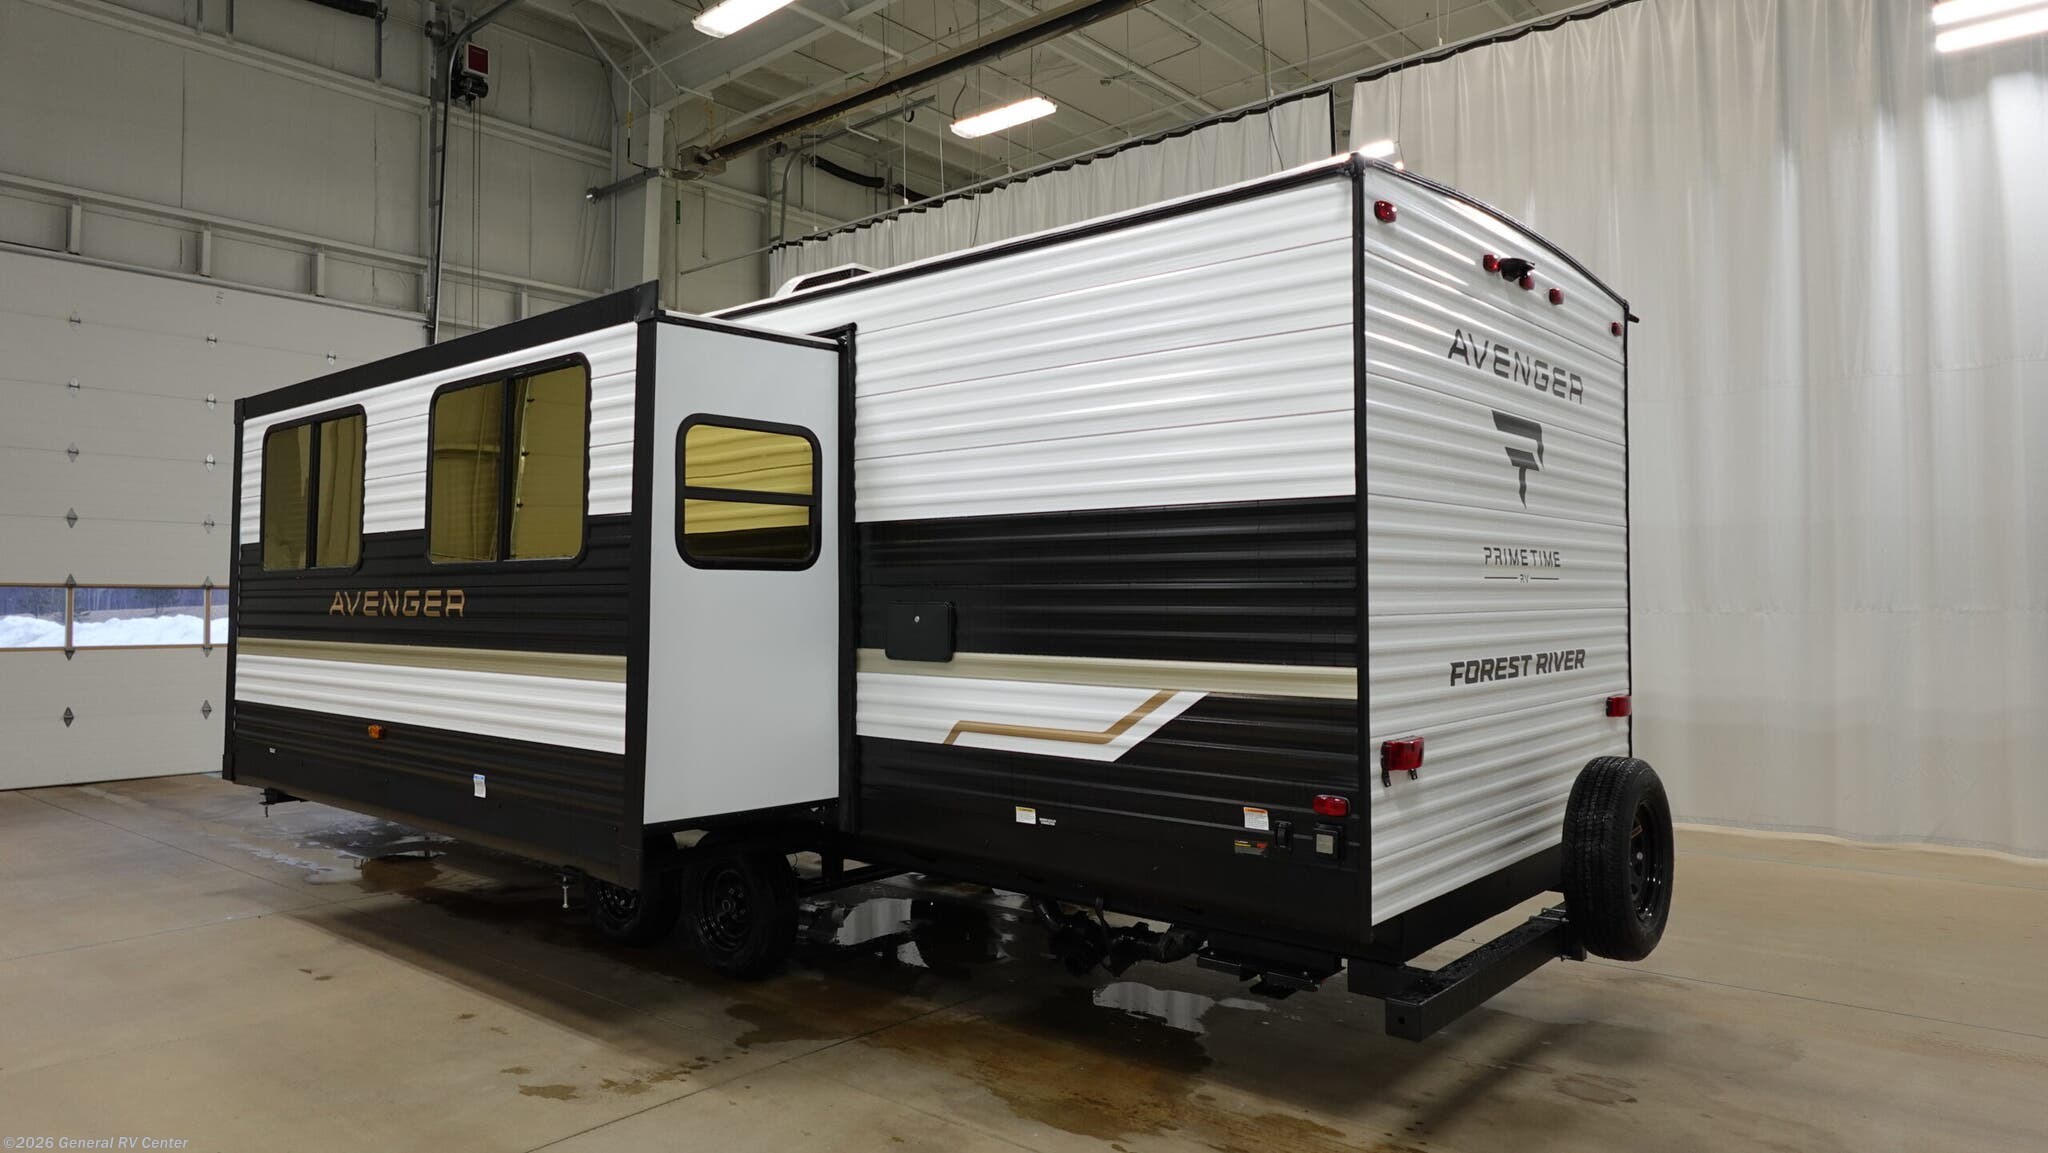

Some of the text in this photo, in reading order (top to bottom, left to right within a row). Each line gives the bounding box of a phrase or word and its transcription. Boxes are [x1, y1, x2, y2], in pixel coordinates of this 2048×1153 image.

[1448, 328, 1584, 404] AVENGER
[329, 589, 466, 618] AVENGER
[1450, 649, 1586, 687] FOREST RIVER
